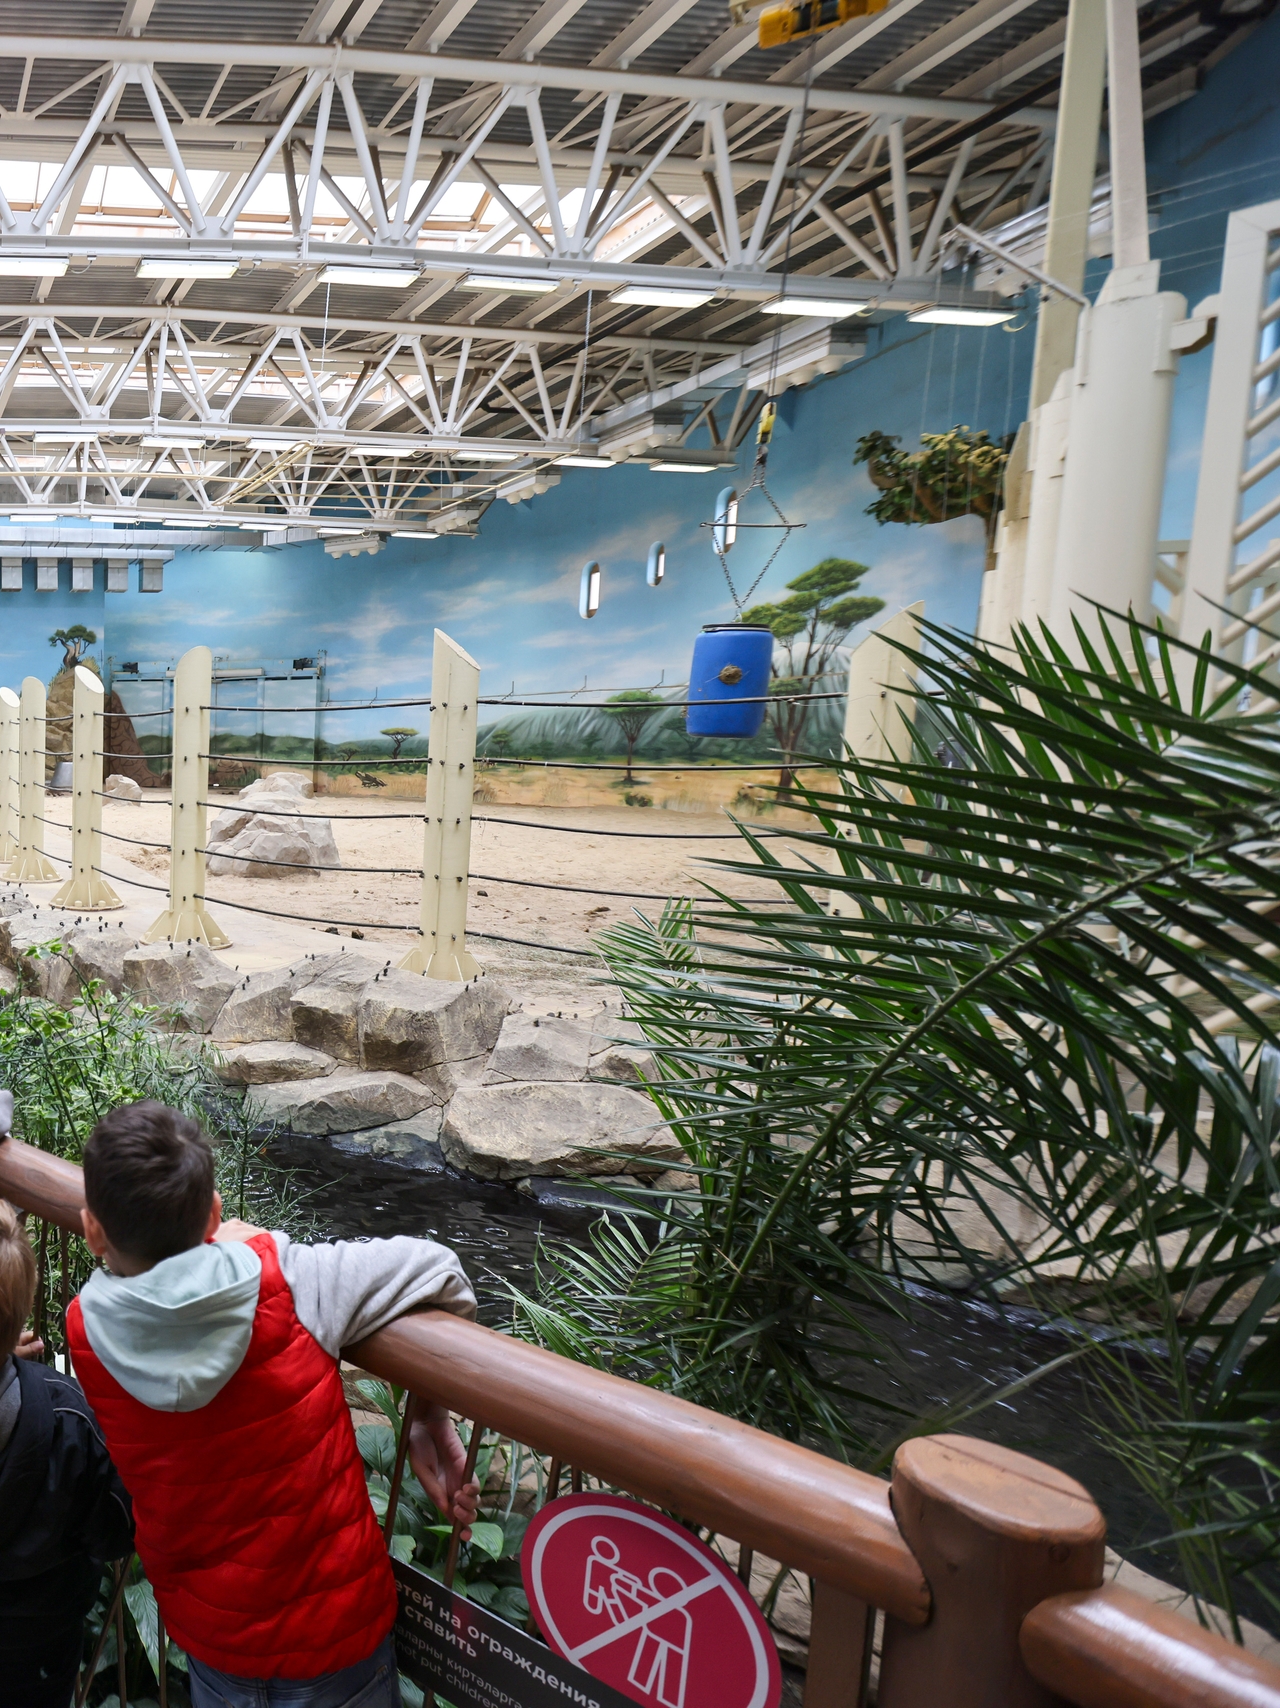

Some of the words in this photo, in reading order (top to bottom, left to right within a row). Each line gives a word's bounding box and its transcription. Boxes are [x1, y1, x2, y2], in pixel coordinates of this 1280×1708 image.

[404, 1605, 478, 1658] ставить
[439, 1607, 462, 1630] на
[396, 1641, 417, 1660] not
[420, 1656, 442, 1676] put
